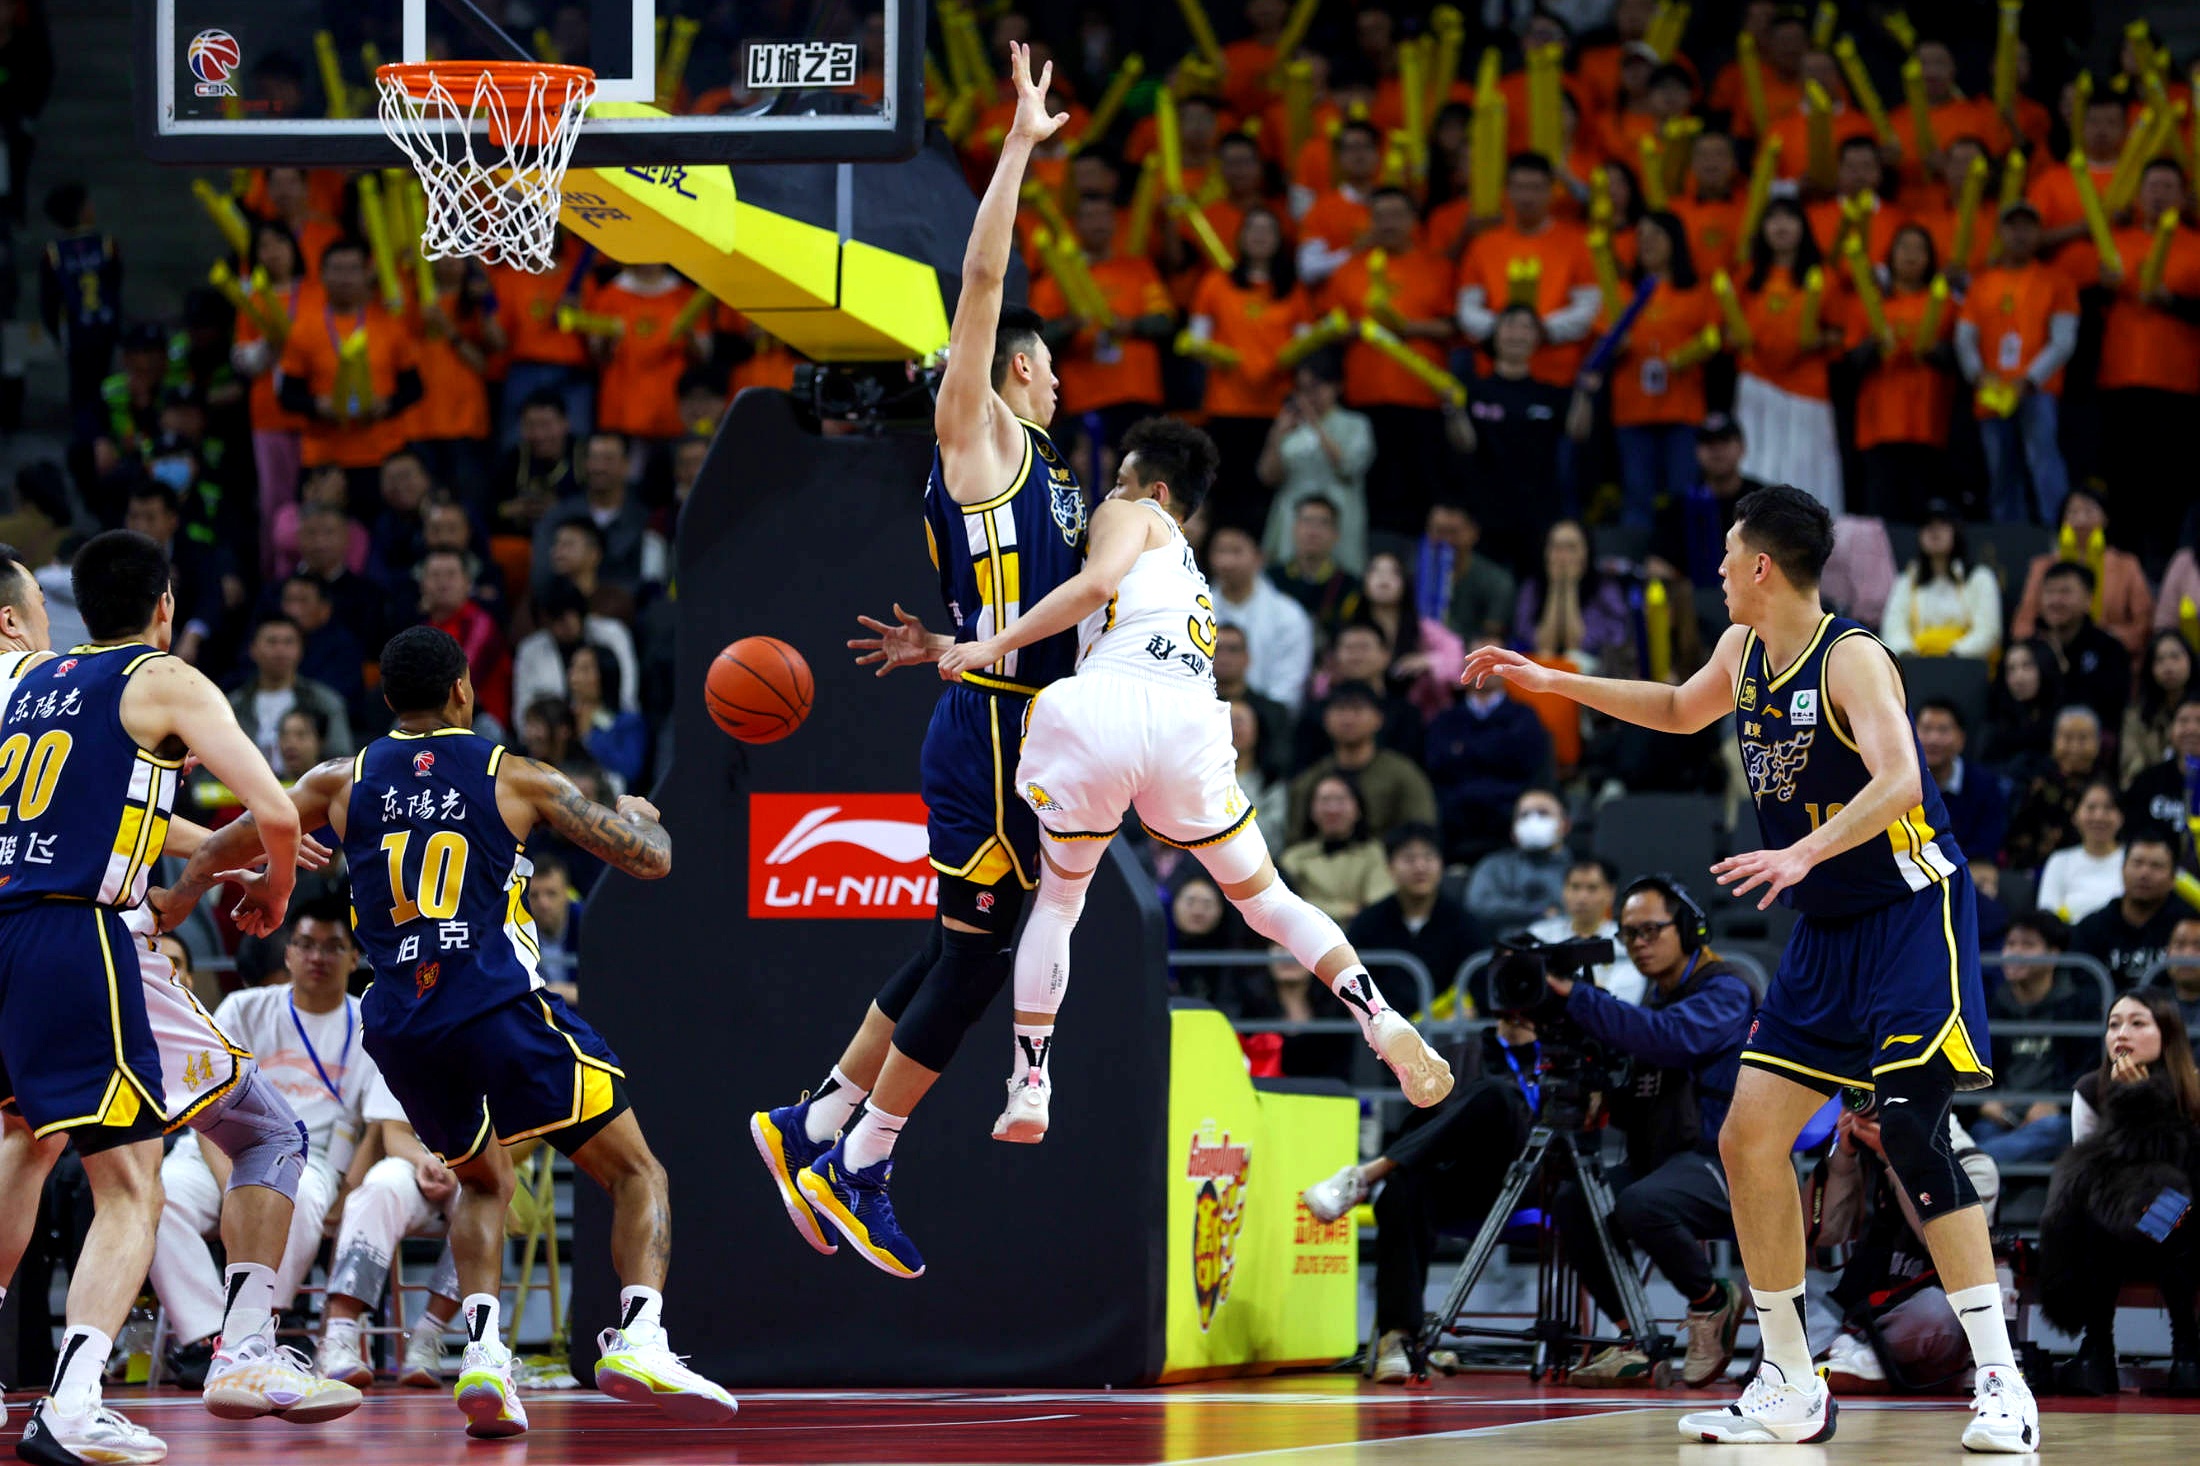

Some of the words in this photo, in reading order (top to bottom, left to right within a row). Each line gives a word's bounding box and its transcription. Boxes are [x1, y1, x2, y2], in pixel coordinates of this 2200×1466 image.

[749, 44, 855, 85] 以城之名
[195, 83, 237, 97] CBA
[380, 830, 469, 928] 10
[396, 920, 470, 964] 伯克
